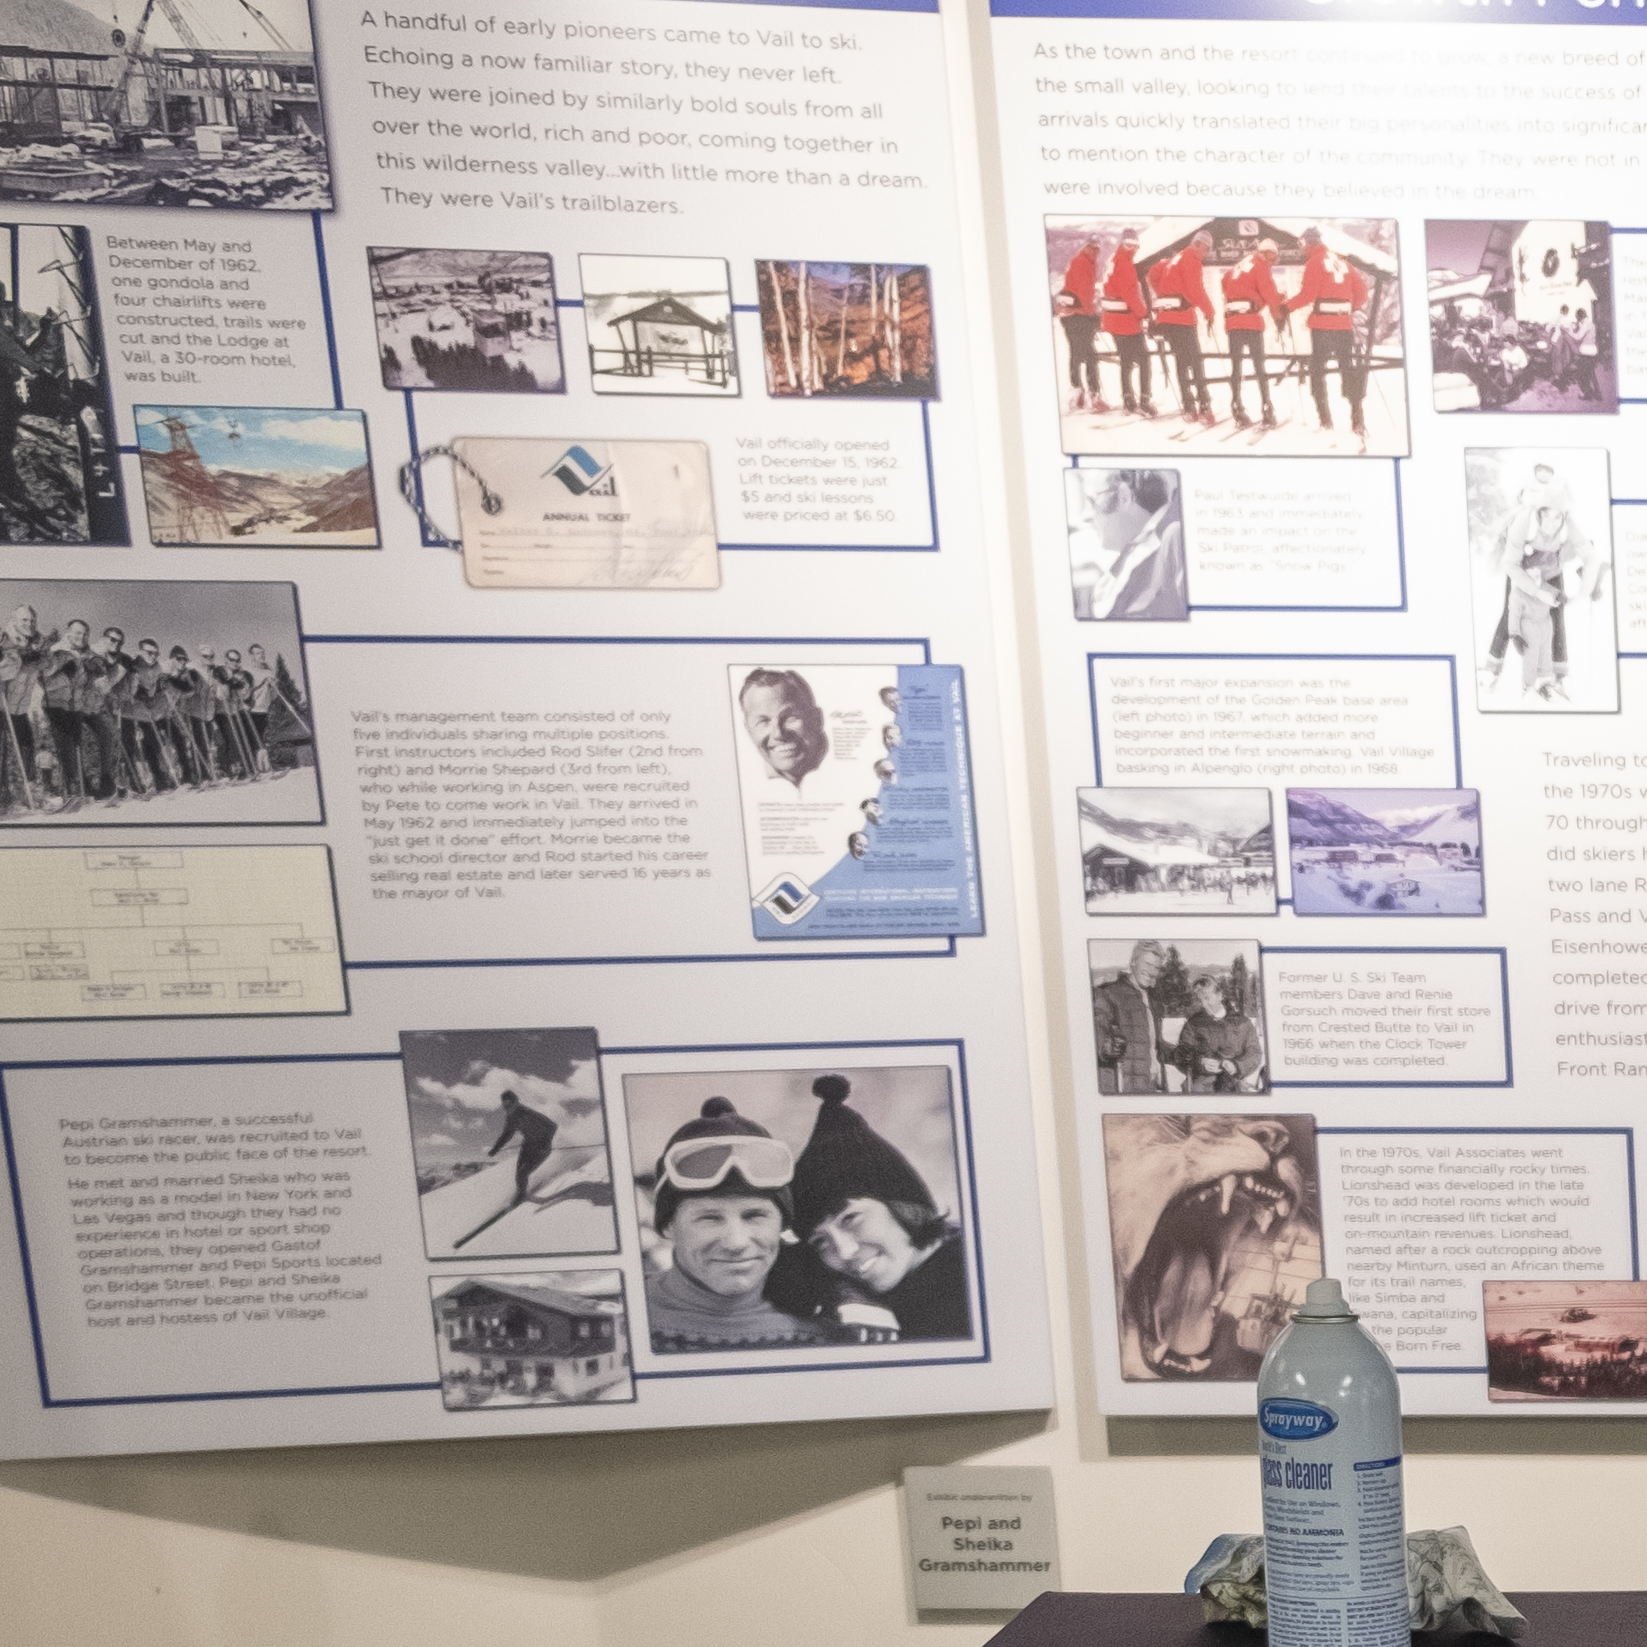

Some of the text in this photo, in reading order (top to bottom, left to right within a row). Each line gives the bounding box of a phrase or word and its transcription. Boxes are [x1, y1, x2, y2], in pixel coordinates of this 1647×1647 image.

[360, 9, 860, 50] A handful of early pioneers came to Vail to ski.
[363, 44, 842, 84] Echoing a now familiar story, they never left.
[379, 186, 683, 214] They were Vail's trailblazers.
[1543, 751, 1626, 770] Traveling
[1557, 1061, 1607, 1077] Front
[1264, 1406, 1323, 1431] Sprayway
[1285, 1456, 1333, 1490] cleaner
[941, 1515, 1021, 1532] Pepi and
[953, 1537, 1013, 1551] Sheika
[918, 1558, 1051, 1572] Gramshammer
